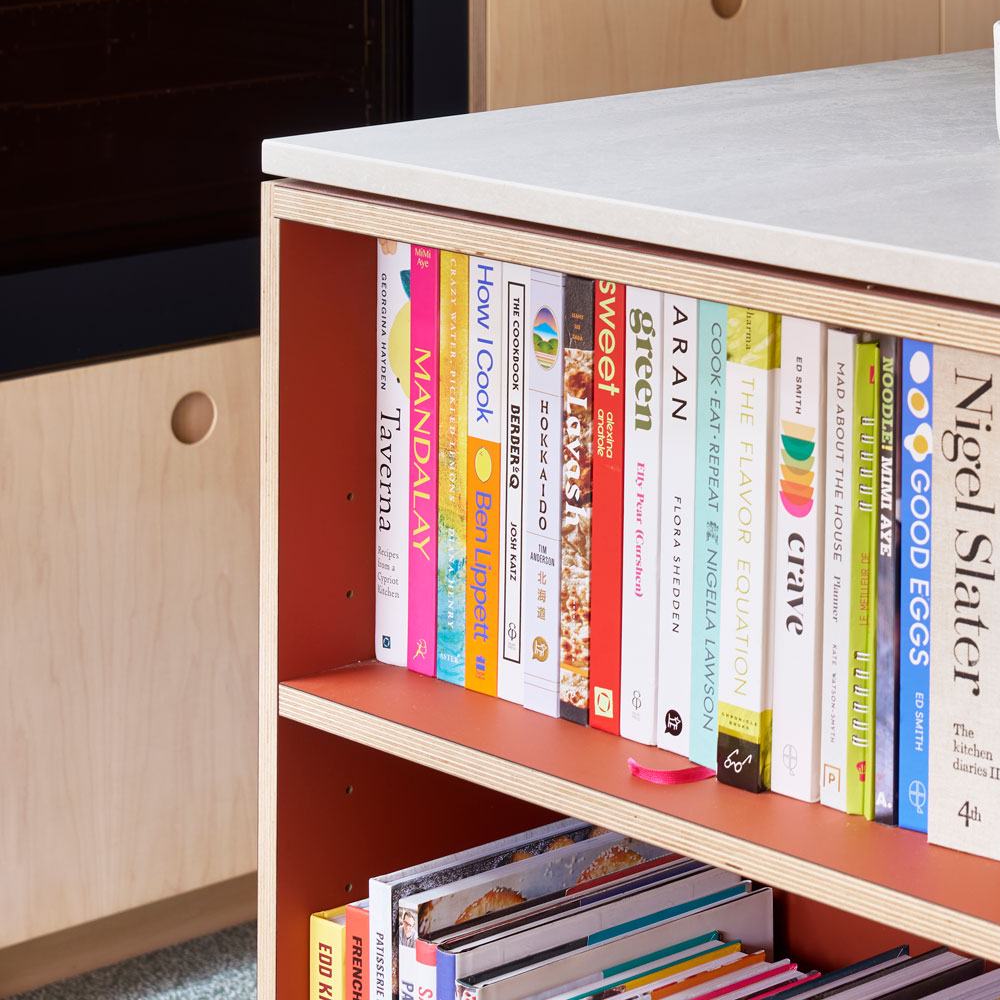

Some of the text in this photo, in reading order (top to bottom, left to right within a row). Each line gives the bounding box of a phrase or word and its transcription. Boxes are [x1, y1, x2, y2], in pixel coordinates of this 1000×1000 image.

[417, 258, 429, 269] Aye
[477, 264, 493, 330] How
[598, 280, 620, 396] sweet
[745, 309, 755, 350] harma
[476, 349, 493, 423] Cook
[629, 308, 656, 432] green
[672, 305, 688, 421] ARAN
[796, 356, 802, 372] ED
[837, 362, 845, 399] MAD
[413, 348, 431, 560] MANDALAY
[565, 392, 587, 525] Lavash
[835, 404, 844, 462] ABOUT
[880, 357, 894, 557] NOODLE! MIMI AYE
[379, 407, 401, 532] Taverna
[539, 400, 549, 531] HOKKAIDO
[835, 468, 843, 498] THE
[378, 546, 399, 560] Recipes
[530, 552, 555, 566] ANDERSON
[538, 544, 547, 554] TIM
[634, 462, 645, 597] Elly Pear (Curshen)
[734, 378, 755, 697] THE FLAVOR EQUATION
[833, 505, 842, 561] HOUSE
[941, 368, 996, 697] Nigel Slater
[378, 558, 390, 570] from
[378, 572, 399, 585] Cypriot
[378, 584, 399, 599] Kitchen
[470, 490, 492, 642] Ben Lippett
[672, 496, 682, 633] FLORA SHEDDEN
[785, 532, 806, 636] crave
[909, 469, 930, 666] GOOD EGGS
[833, 576, 841, 623] Planner
[703, 549, 718, 731] NIGELLA LAWSON
[830, 672, 838, 743] WATSON-SMYTH
[915, 692, 924, 751] ED SMITH
[953, 723, 975, 739] The
[953, 740, 993, 761] kitchen
[953, 761, 1000, 781] diaries II
[958, 801, 981, 827] 4th
[319, 942, 332, 978] EDD
[353, 936, 362, 1000] FRENCH
[376, 932, 384, 997] PATISSERIE
